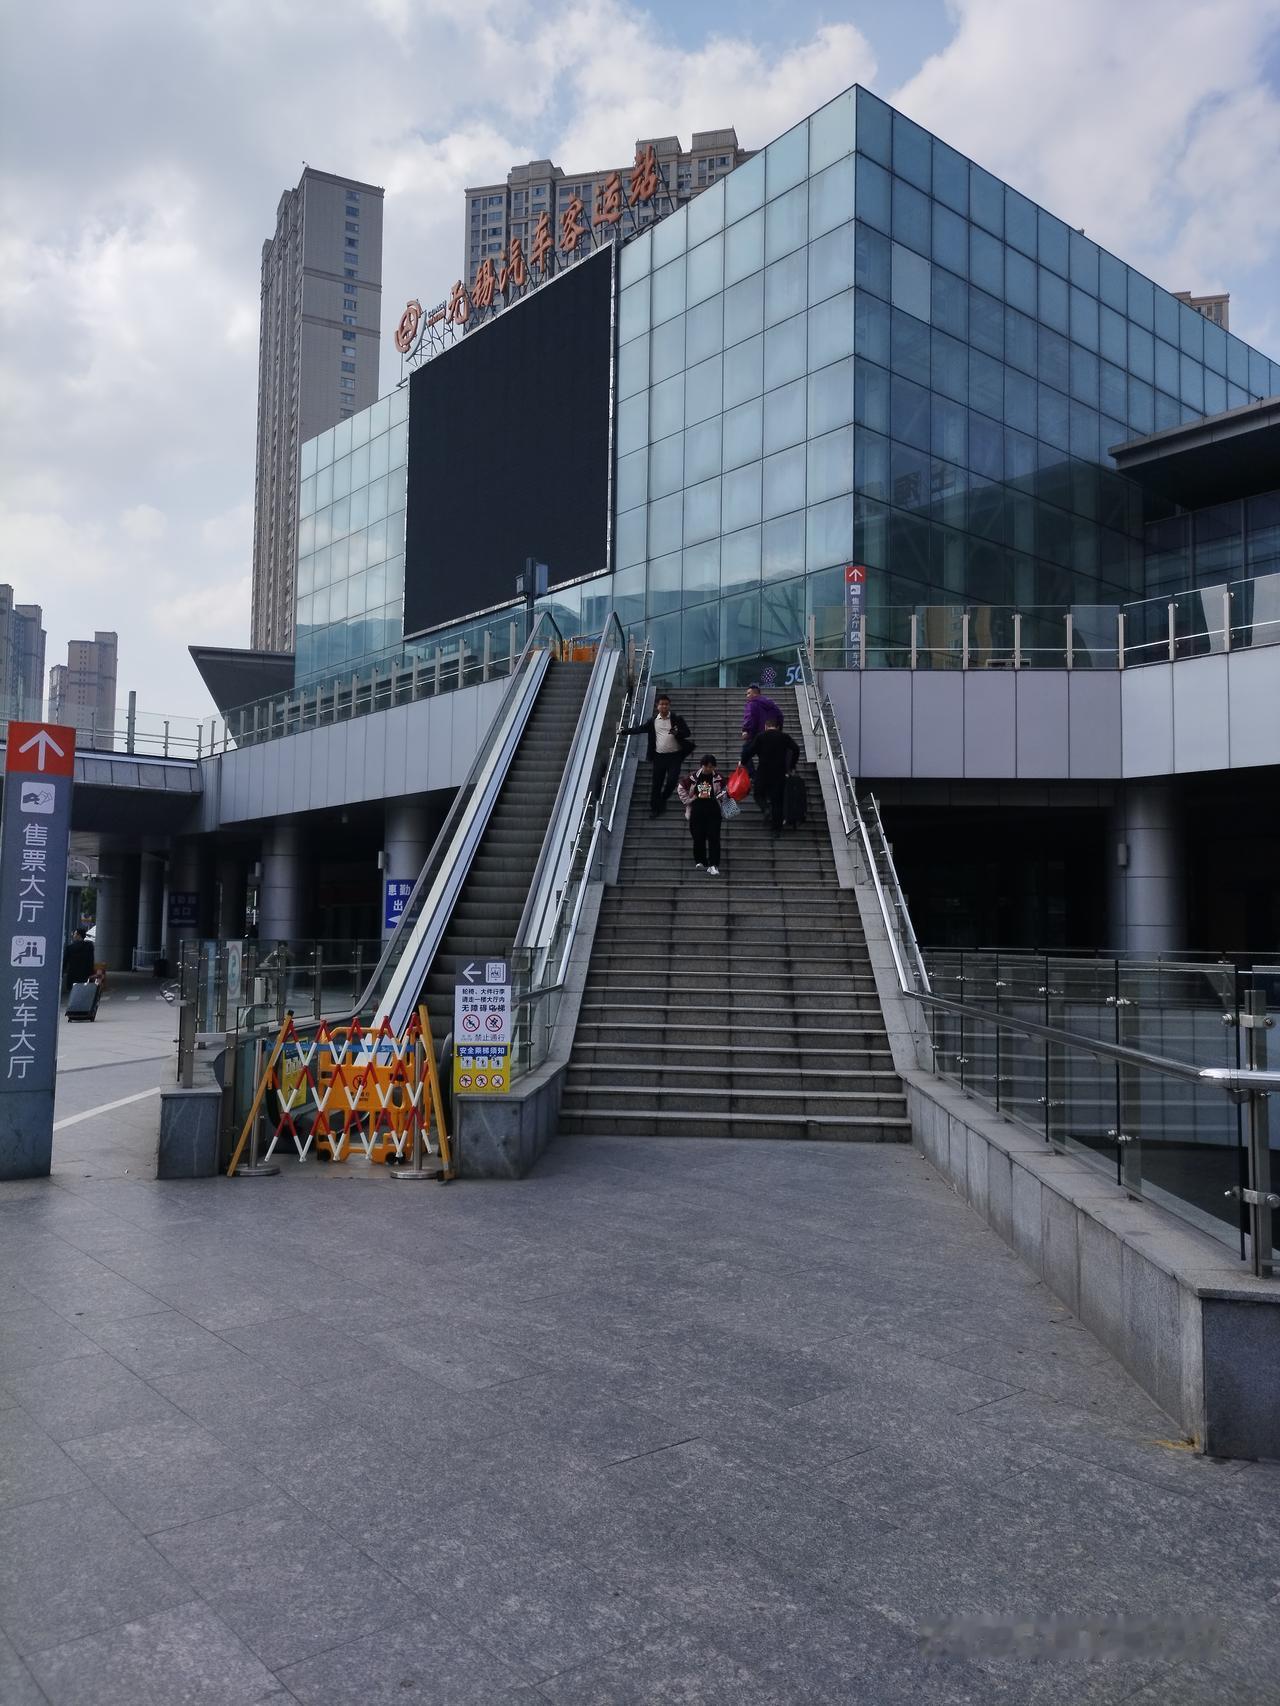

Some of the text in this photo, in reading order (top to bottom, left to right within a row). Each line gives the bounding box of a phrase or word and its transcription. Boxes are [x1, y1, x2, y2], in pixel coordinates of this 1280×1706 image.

[17, 823, 49, 923] 售票大厅
[7, 977, 40, 1080] 候车大厅
[462, 1004, 506, 1012] 无障碍电梯
[460, 1047, 505, 1055] 安全乘梯须知
